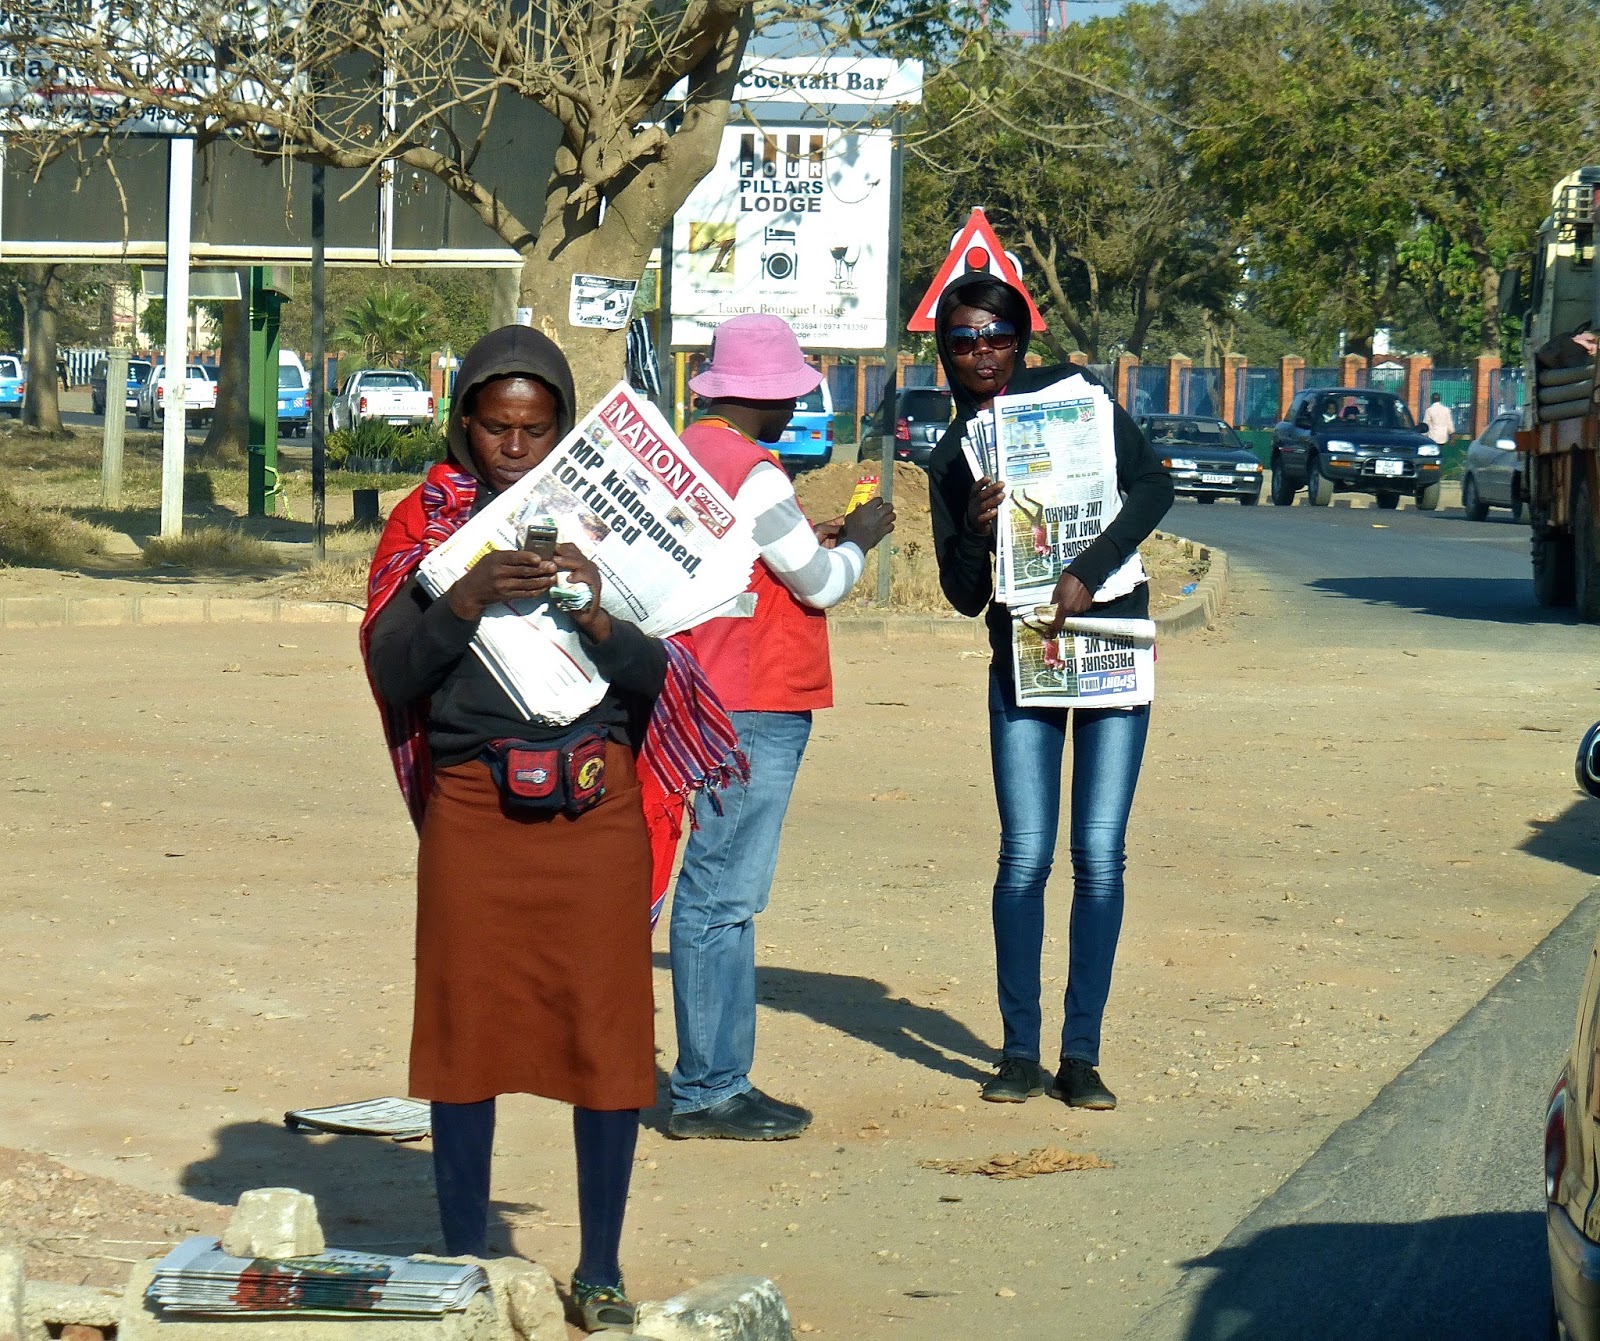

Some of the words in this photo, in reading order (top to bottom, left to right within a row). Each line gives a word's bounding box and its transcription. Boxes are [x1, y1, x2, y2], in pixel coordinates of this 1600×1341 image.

[738, 72, 838, 90] Cocktail
[846, 72, 887, 91] Bar
[741, 162, 823, 177] FOUR
[740, 180, 823, 194] PILLARS
[740, 197, 822, 213] LODGE
[719, 302, 756, 313] Luxury
[760, 303, 809, 317] Boutique
[812, 304, 846, 318] Lodge
[608, 401, 691, 492] NATION
[551, 456, 642, 546] tortured
[568, 437, 604, 470] MP
[601, 469, 702, 579] kidnapped,
[1045, 504, 1079, 523] RENARD
[1086, 501, 1102, 518] LIKE
[1065, 523, 1077, 539] WE
[1079, 518, 1102, 537] WHAT
[1085, 638, 1101, 654] WE
[1104, 635, 1134, 651] WHAT
[1066, 658, 1077, 674] IS
[1081, 652, 1135, 673] PRESSURE
[1101, 674, 1136, 689] SPORT
